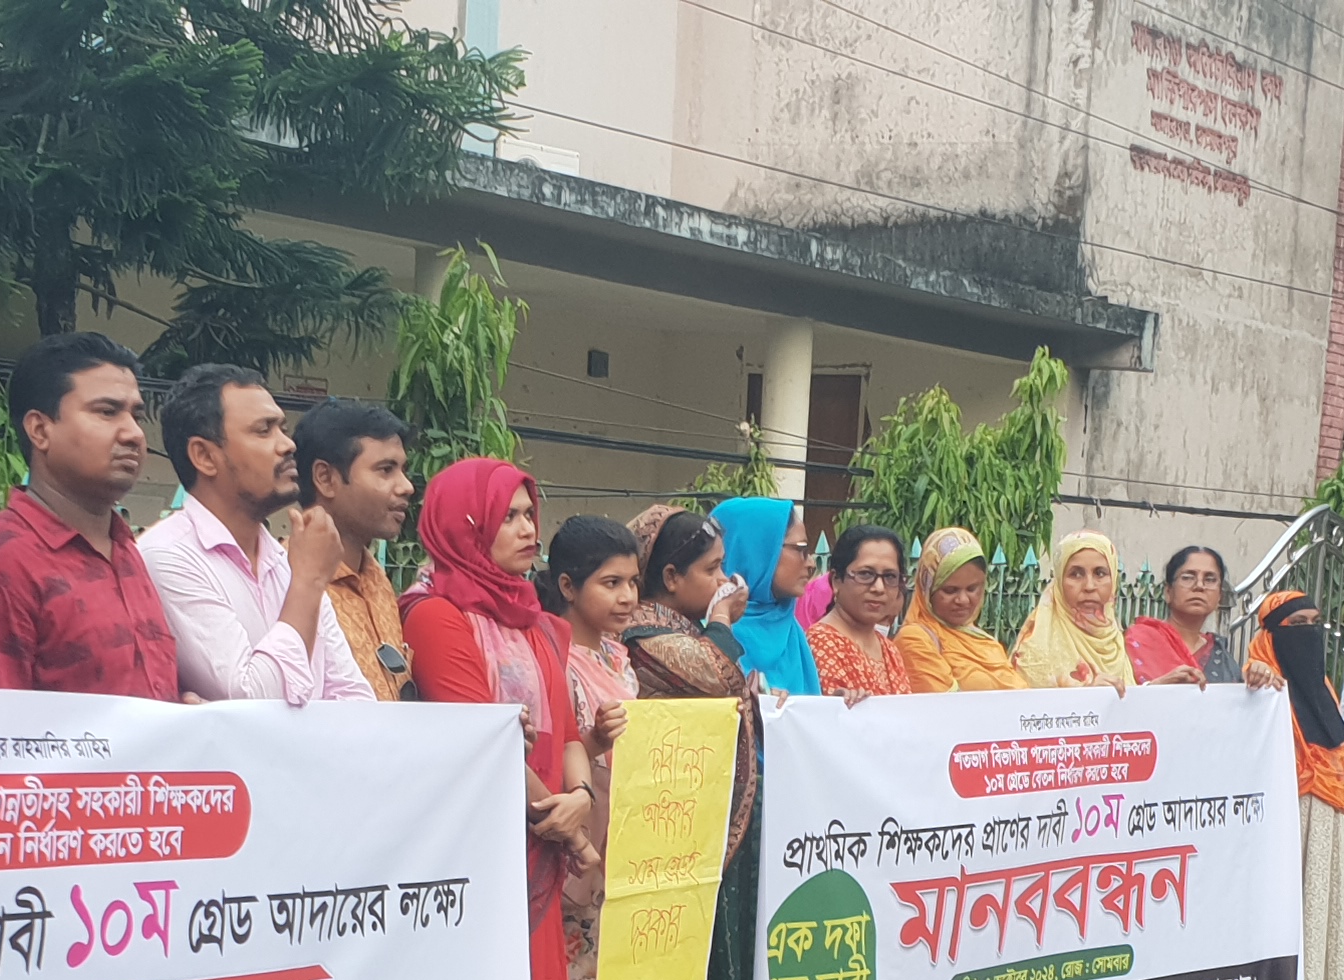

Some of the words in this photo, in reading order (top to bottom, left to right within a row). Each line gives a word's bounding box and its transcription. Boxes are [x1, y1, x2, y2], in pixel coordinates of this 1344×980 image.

[12, 731, 71, 760] রাহমানির
[72, 732, 111, 759] রাহিম
[953, 747, 988, 770] শতভাগ
[990, 741, 1028, 766] বিভাগীয়
[76, 775, 145, 817] সহকারী
[148, 775, 236, 815] শিক্ষকদের
[984, 773, 1004, 794] ১০ম
[1032, 768, 1055, 789] বেতন
[1110, 763, 1129, 781] হবে
[17, 818, 84, 864] নির্ধারণ
[87, 827, 145, 860] করতে
[147, 826, 184, 858] হবে
[783, 819, 871, 877] প্রাথমিক
[878, 817, 976, 866] শিক্ষকদের
[981, 813, 1031, 855] প্রাণের
[1037, 798, 1069, 848] দাবী
[1072, 794, 1125, 843] ১০ম
[1128, 797, 1158, 838] গ্রেড
[1162, 795, 1228, 831] আদায়ের
[67, 879, 180, 969] ১০ম
[188, 892, 258, 957] গ্রেড
[268, 881, 389, 945] আদায়ের
[399, 876, 469, 929] লক্ষ্যে
[889, 844, 1199, 965] মানববন্ধন
[767, 920, 817, 964] এক
[823, 910, 870, 959] দফা
[1091, 952, 1130, 975] সোমবার
